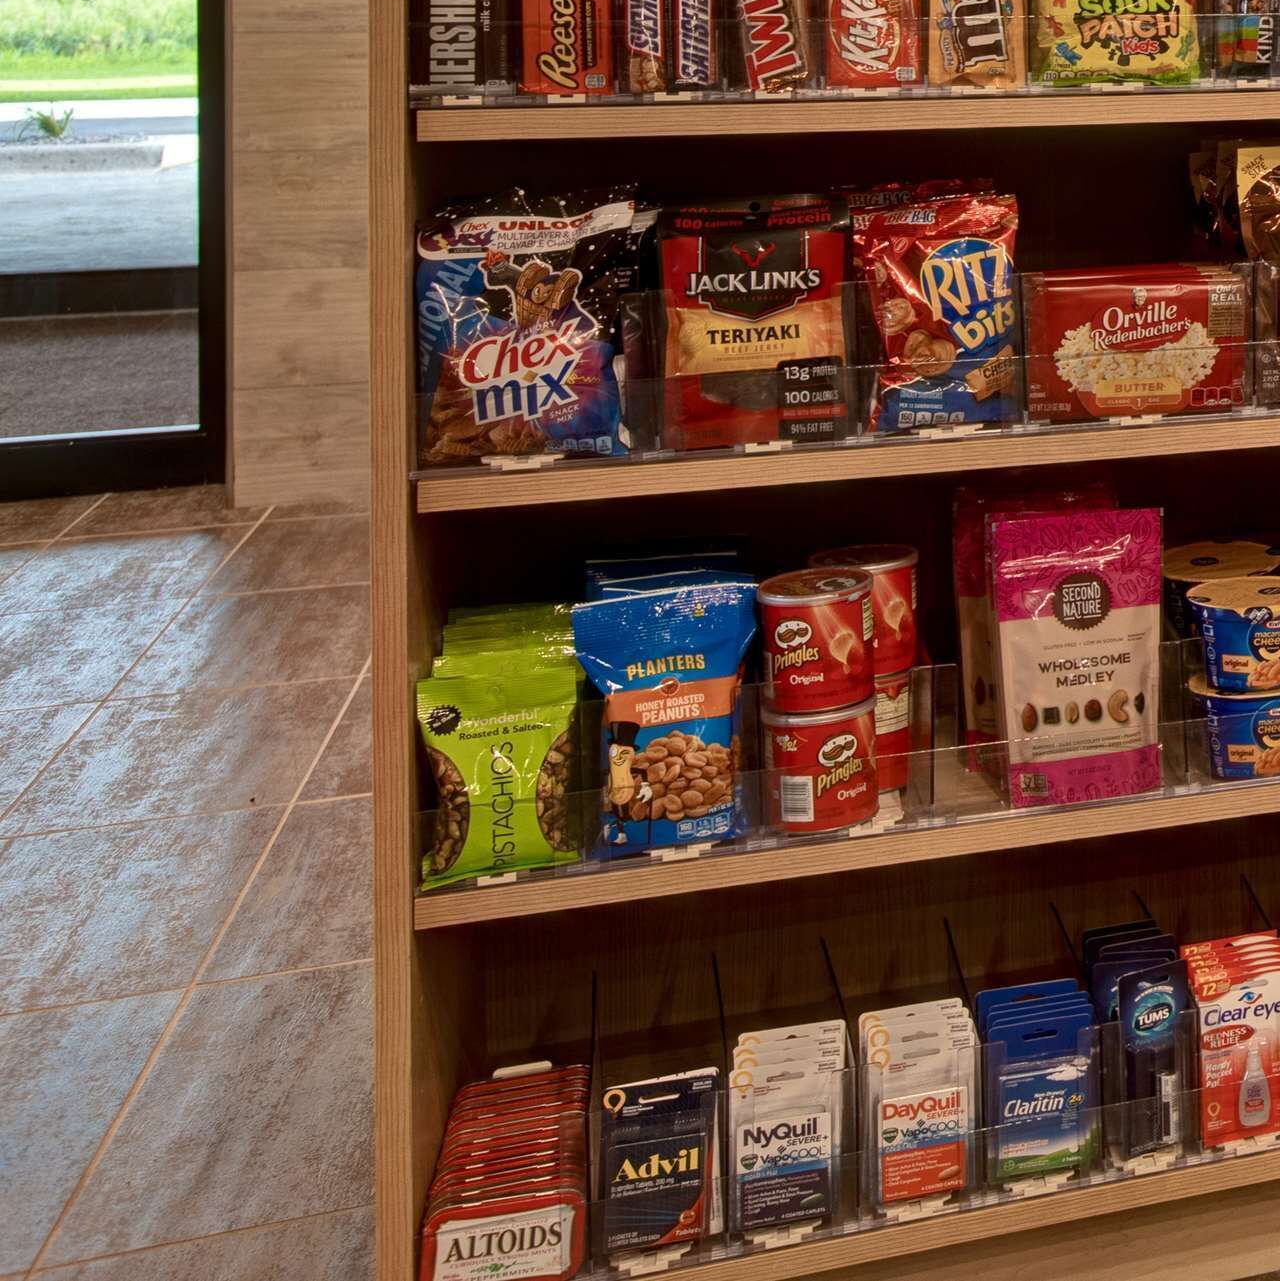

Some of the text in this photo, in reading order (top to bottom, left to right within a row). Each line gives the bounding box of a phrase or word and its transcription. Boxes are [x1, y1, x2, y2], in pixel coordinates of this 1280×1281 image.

[480, 8, 491, 32] milk
[1080, 13, 1178, 45] PATCH
[1122, 38, 1160, 55] Kids
[1256, 16, 1274, 64] KIND
[1242, 154, 1265, 172] SNACK
[1249, 162, 1267, 178] SIZE
[459, 220, 490, 233] Chex
[497, 230, 561, 241] MULTIPLAYER
[687, 268, 821, 296] JACK LINK'S
[922, 245, 1012, 321] RITZ
[1211, 292, 1244, 304] REAL
[953, 301, 1016, 350] bits
[1102, 300, 1178, 332] Orville
[706, 323, 801, 346] TERIYAKI
[1091, 316, 1192, 351] Redenbacher's
[464, 322, 576, 385] Chex
[723, 342, 785, 354] BEEF JERKY
[783, 365, 810, 381] 13g
[475, 359, 576, 421] mix
[1114, 380, 1165, 394] BUTTER
[785, 390, 810, 404] 100
[550, 404, 580, 417] SNACK
[556, 413, 574, 423] MIX
[806, 421, 834, 433] FAT FREE
[1062, 584, 1102, 602] SECOND
[1063, 599, 1102, 618] NATURE
[626, 654, 706, 681] PLANTERS
[774, 645, 820, 675] Pringles
[1038, 652, 1131, 675] WHOLESOME
[1224, 658, 1249, 669] original
[789, 672, 824, 686] Original
[1056, 670, 1115, 689] MEDLEY
[635, 693, 705, 713] HONEY ROASTED
[641, 705, 701, 726] PEANUTS
[458, 722, 544, 741] Roasted & Salted
[1230, 749, 1254, 759] original
[816, 757, 864, 797] Pringles
[490, 741, 516, 869] PISTACHIOS
[1202, 982, 1217, 997] 12
[1137, 1007, 1169, 1026] TUMS
[1204, 1005, 1251, 1027] Clear
[1203, 1026, 1248, 1043] REDNESS
[1210, 1036, 1241, 1048] RELIEF
[1206, 1060, 1232, 1072] Handy
[1206, 1068, 1233, 1080] Pocket
[882, 1090, 961, 1121] DayQuil
[1003, 1094, 1065, 1118] Claritin
[743, 1116, 818, 1149] NyQuil
[900, 1119, 963, 1139] VapoCOOL
[611, 1146, 700, 1184] Advil
[760, 1146, 827, 1165] VapoCOOL
[441, 1220, 562, 1265] ALTOIDS
[530, 1248, 557, 1257] MINTS
